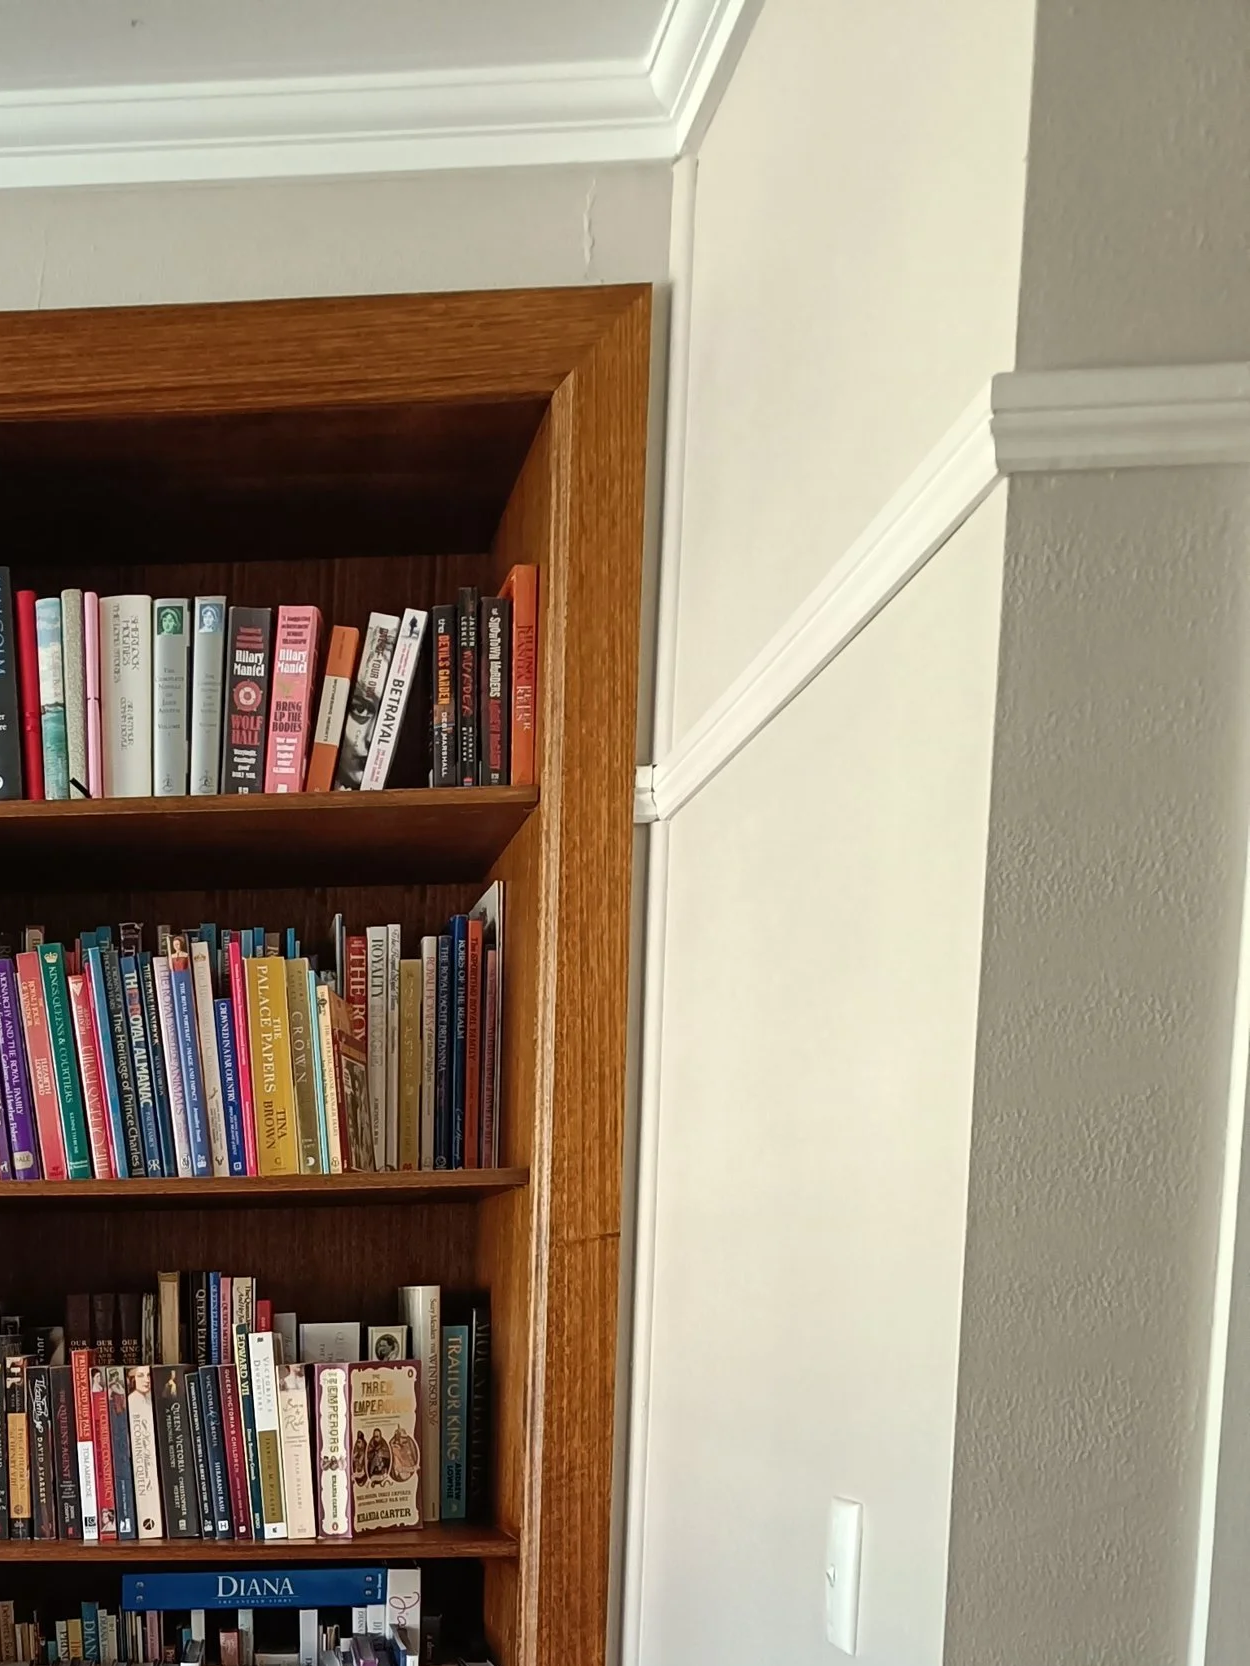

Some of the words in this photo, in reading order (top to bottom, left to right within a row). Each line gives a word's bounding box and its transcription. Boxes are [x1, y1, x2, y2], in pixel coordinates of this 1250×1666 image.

[231, 715, 263, 730] WOLF
[274, 712, 285, 723] UP
[287, 712, 302, 722] THE
[275, 701, 302, 712] BRING
[377, 677, 404, 746] BETRAYAL
[231, 729, 260, 745] HALL
[272, 721, 302, 733] BODIES
[370, 938, 383, 997] ROYALTY
[0, 972, 11, 1018] MONARCHY
[256, 964, 271, 1027] PALACE
[5, 1019, 13, 1038] AND
[112, 1012, 123, 1032] The
[272, 1017, 282, 1039] THE
[7, 1040, 15, 1057] THE
[113, 1033, 128, 1078] Heritage
[260, 1032, 275, 1093] PAPERS
[292, 1010, 306, 1083] CROWN
[10, 1059, 19, 1085] ROYAL
[121, 1079, 131, 1091] of
[13, 1087, 23, 1115] FAMILY
[122, 1093, 135, 1126] Prince
[263, 1100, 276, 1149] BROWN
[276, 1107, 287, 1139] TINA
[127, 1127, 140, 1166] Charles
[236, 1333, 248, 1379] EDWARD
[241, 1381, 249, 1395] VII
[428, 1353, 437, 1407] WINDSOR
[171, 1402, 181, 1431] QUEEN
[132, 1414, 142, 1458] BECOMING
[175, 1434, 184, 1473] VICTORIA
[135, 1460, 145, 1496] QUEEN
[453, 1462, 461, 1500] ANDREW
[381, 1508, 411, 1518] CARTER
[216, 1576, 294, 1597] DIANA
